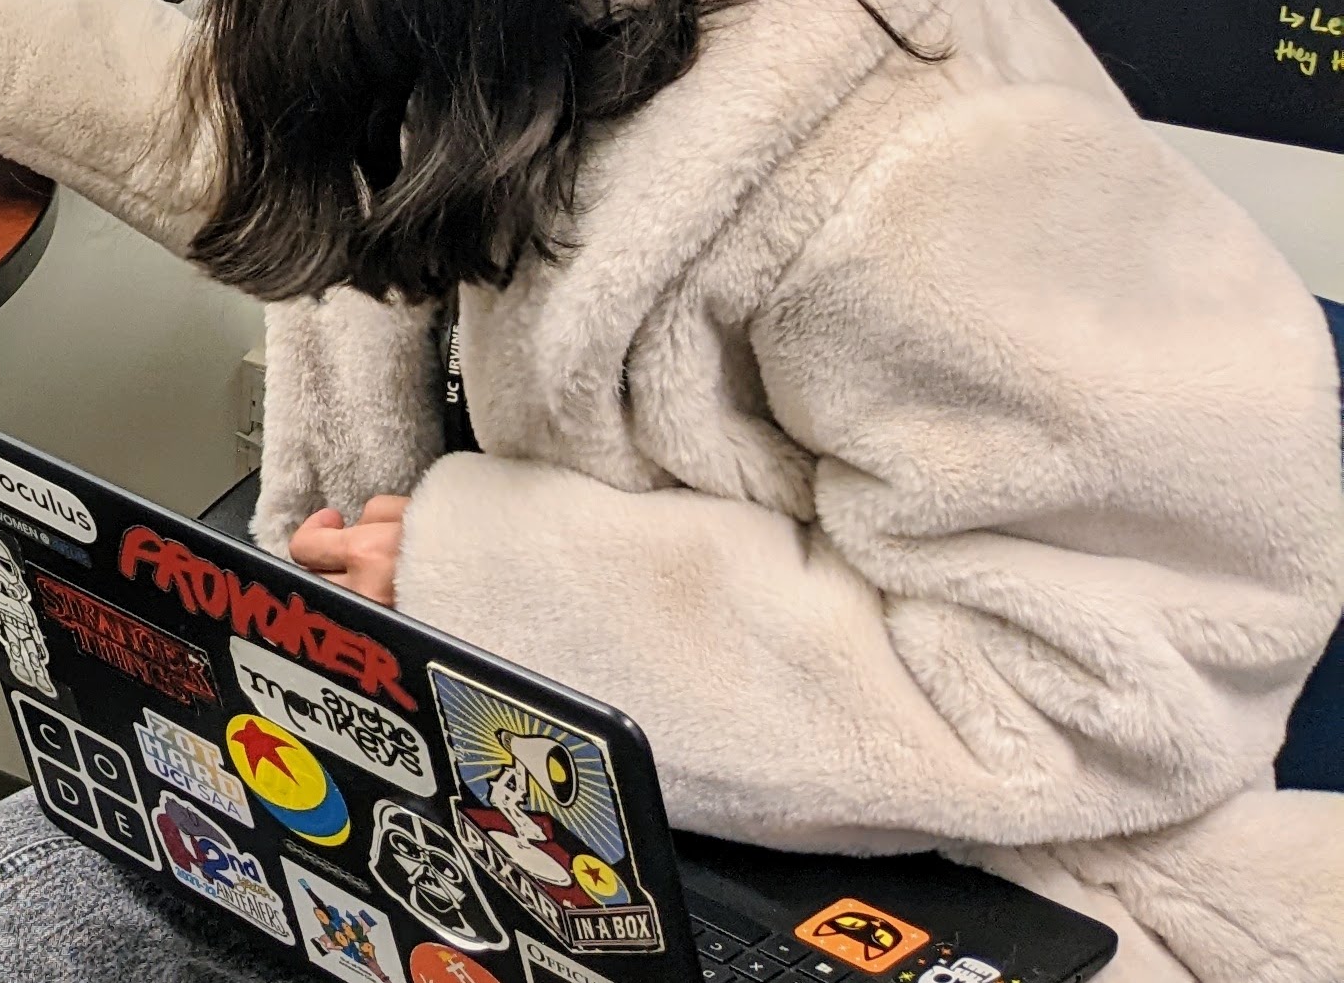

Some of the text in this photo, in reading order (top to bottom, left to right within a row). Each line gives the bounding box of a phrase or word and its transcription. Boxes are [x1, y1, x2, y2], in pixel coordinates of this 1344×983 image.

[446, 380, 460, 404] UC
[36, 572, 217, 701] STRANGER
[118, 523, 419, 712] PROVOKER
[72, 620, 192, 707] THINGS
[148, 713, 220, 767] ZOT
[239, 664, 425, 779] monkeys
[320, 686, 421, 754] arctic
[137, 728, 246, 808] HARD
[198, 780, 243, 822] SAA
[214, 878, 288, 935] ANTEATERS
[461, 816, 562, 933] PIXAR
[574, 914, 654, 940] IN A BOX
